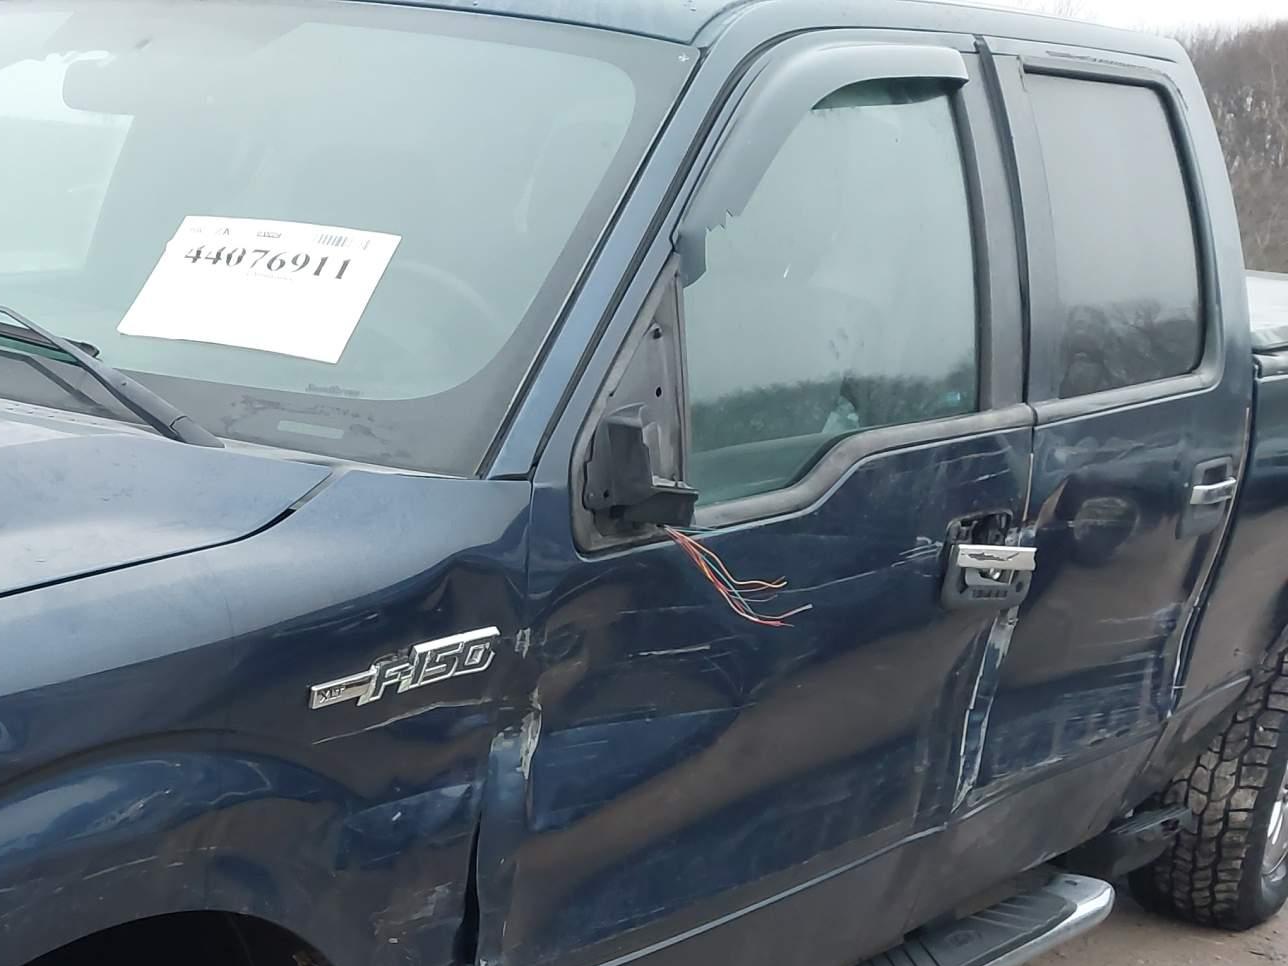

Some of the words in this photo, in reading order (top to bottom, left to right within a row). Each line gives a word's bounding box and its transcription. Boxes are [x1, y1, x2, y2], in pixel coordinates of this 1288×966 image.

[183, 244, 352, 280] 44076911
[316, 686, 346, 704] XLT
[357, 634, 497, 706] F-150
